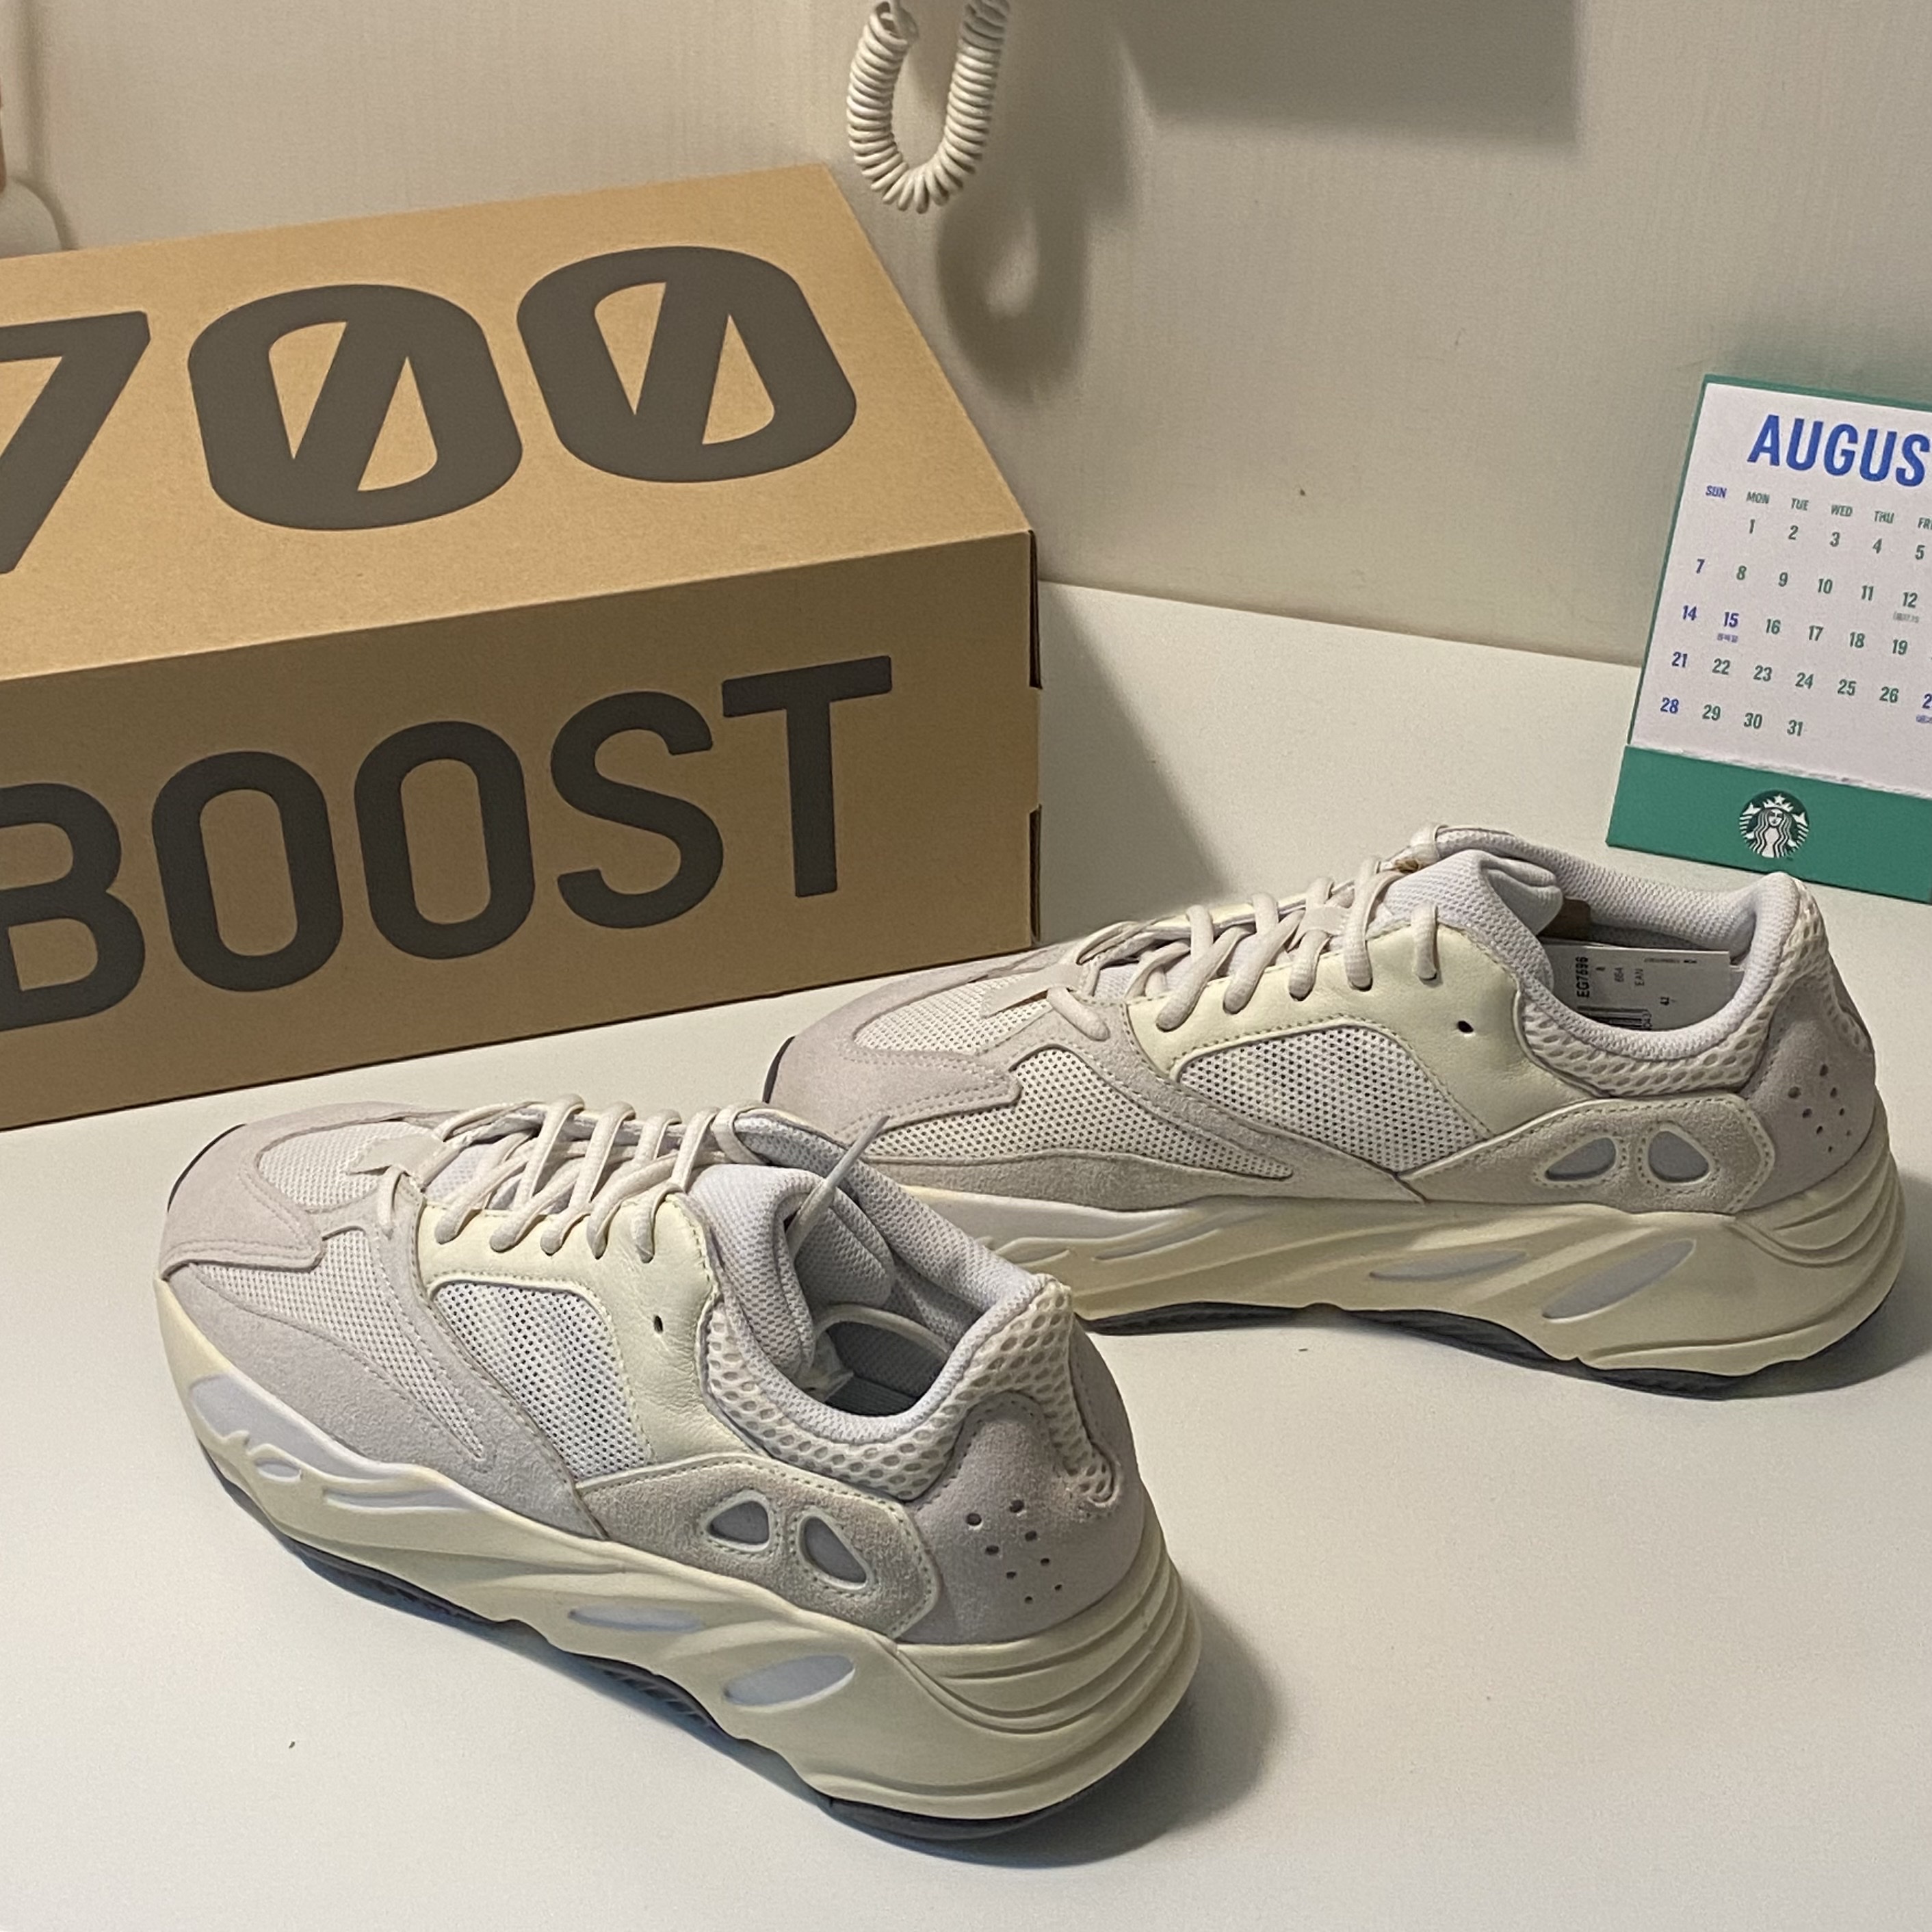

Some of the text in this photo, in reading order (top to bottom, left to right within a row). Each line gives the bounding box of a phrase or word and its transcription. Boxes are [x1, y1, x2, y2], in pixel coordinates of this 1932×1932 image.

[0, 246, 857, 573] 700
[1705, 484, 1727, 499] SUN
[1746, 491, 1771, 505] MON
[1790, 497, 1810, 512] TUE
[1831, 504, 1853, 518] WED
[1874, 510, 1895, 524] THU
[1749, 519, 1926, 561] 1 2 3 4 5
[1695, 558, 1918, 609] 7 8 9 10 11 12
[1682, 605, 1908, 656] 14 15 16 17 18 19
[1671, 651, 1932, 709] 21 22 23 24 25 26 2
[1660, 696, 1803, 737] 28 29 30 31
[0, 655, 892, 1032] BOOST
